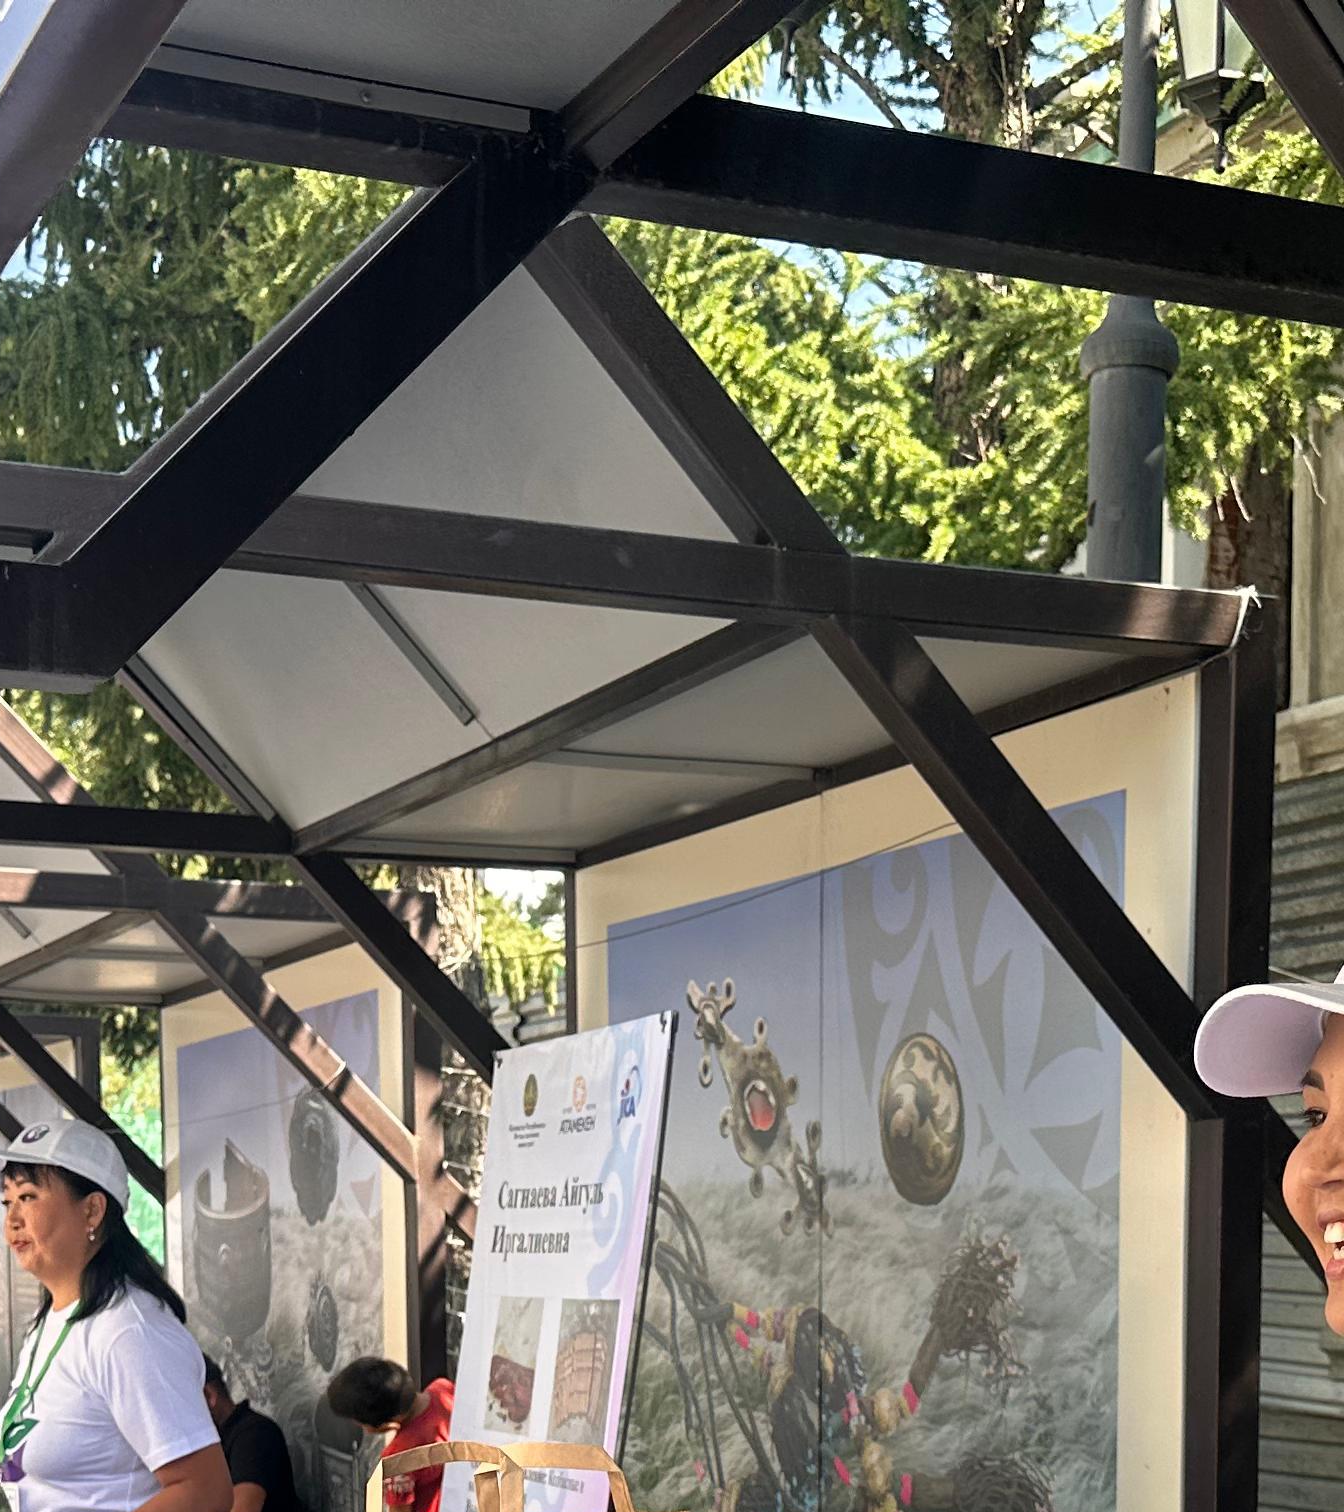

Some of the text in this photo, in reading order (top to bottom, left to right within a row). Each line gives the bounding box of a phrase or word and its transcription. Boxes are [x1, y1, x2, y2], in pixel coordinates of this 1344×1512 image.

[498, 1176, 604, 1215] Сагнаева Айгуль
[491, 1225, 570, 1262] Иргалиевна
